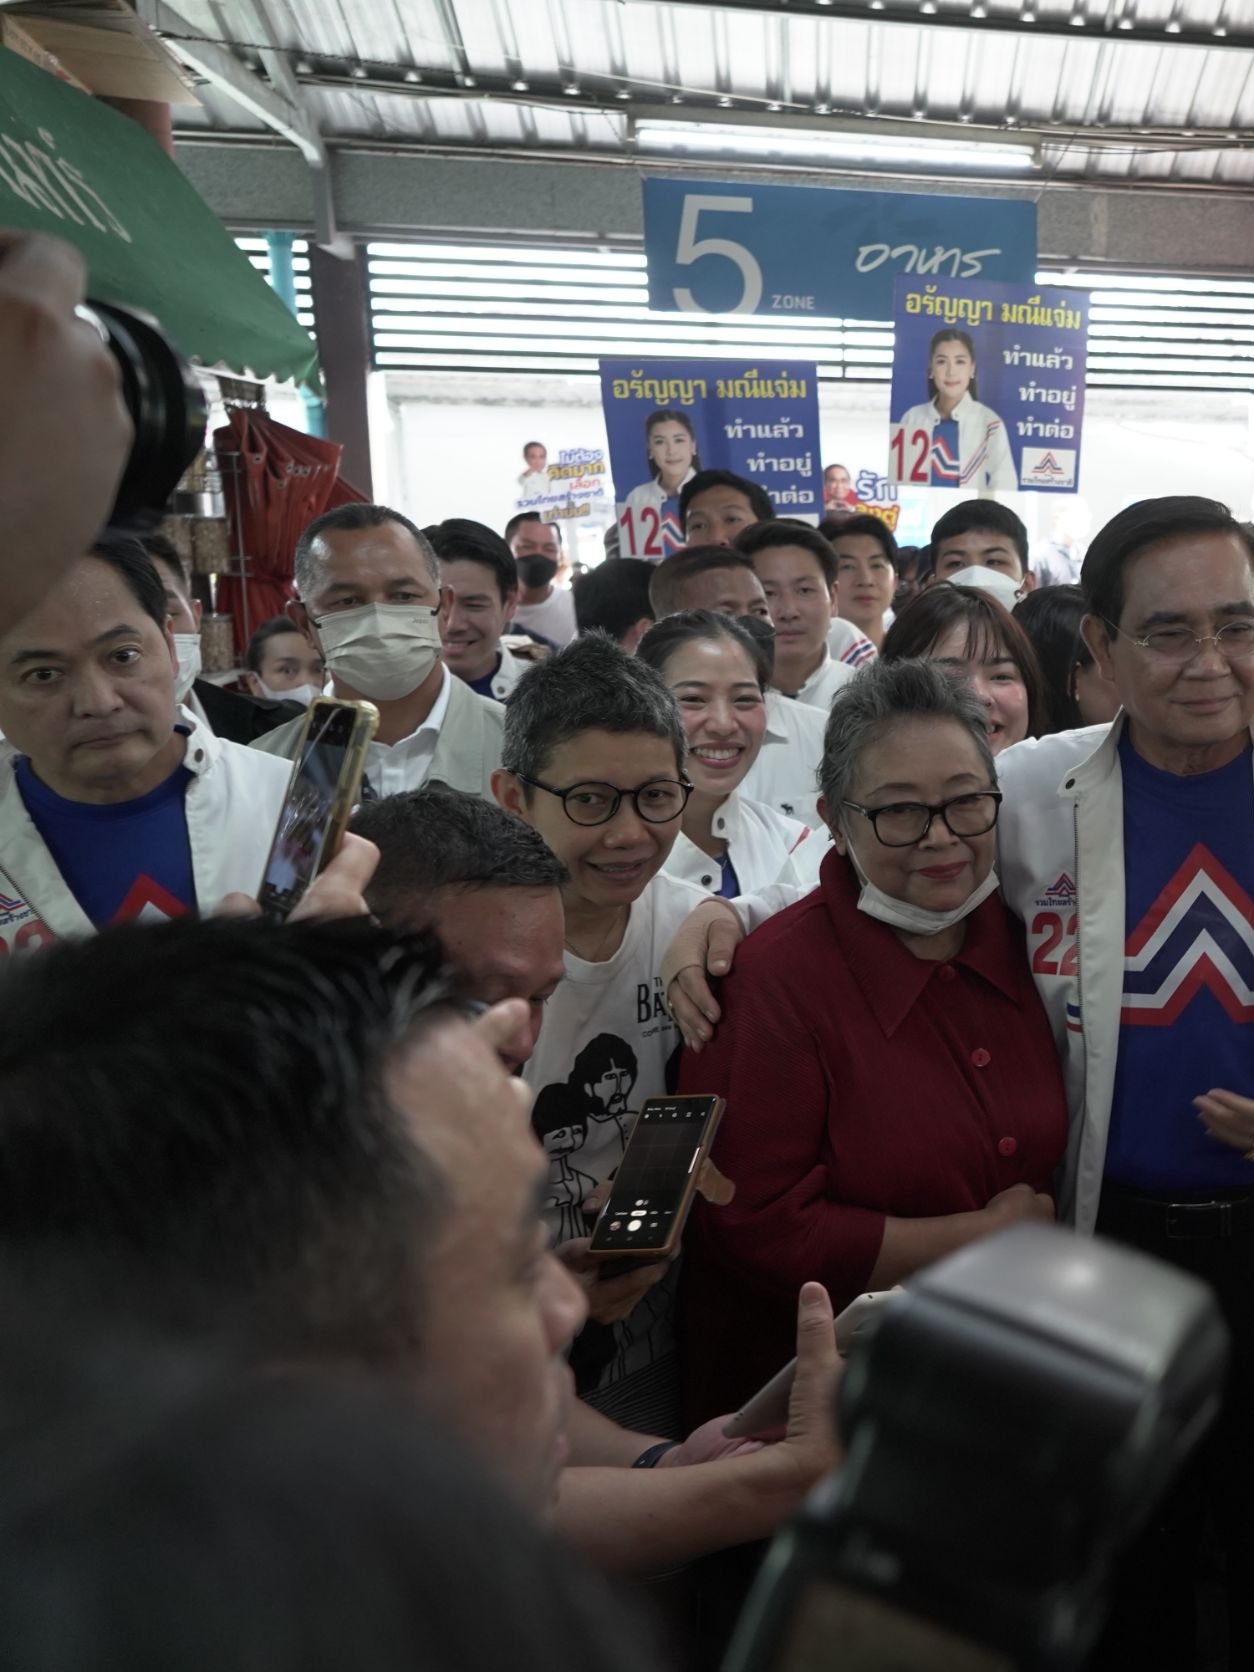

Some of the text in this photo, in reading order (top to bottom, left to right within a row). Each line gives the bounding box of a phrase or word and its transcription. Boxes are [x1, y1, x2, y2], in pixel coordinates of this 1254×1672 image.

[673, 194, 763, 315] 5
[855, 243, 1002, 278] อาหาร
[771, 294, 815, 311] ZONE
[905, 285, 1081, 330] อรัญญา มณีแจ่ม
[1003, 344, 1074, 370] ทำแล้ว
[612, 369, 807, 405] อรัญญา มณีแจ่ม
[1019, 381, 1076, 411] ทำอยู่
[724, 416, 804, 438] ทำแล้ว
[1017, 416, 1075, 439] ทำต่อ
[747, 452, 812, 477] ทำอยู่
[891, 427, 930, 483] 12
[763, 485, 815, 505] ำต่อ
[619, 506, 663, 556] 12
